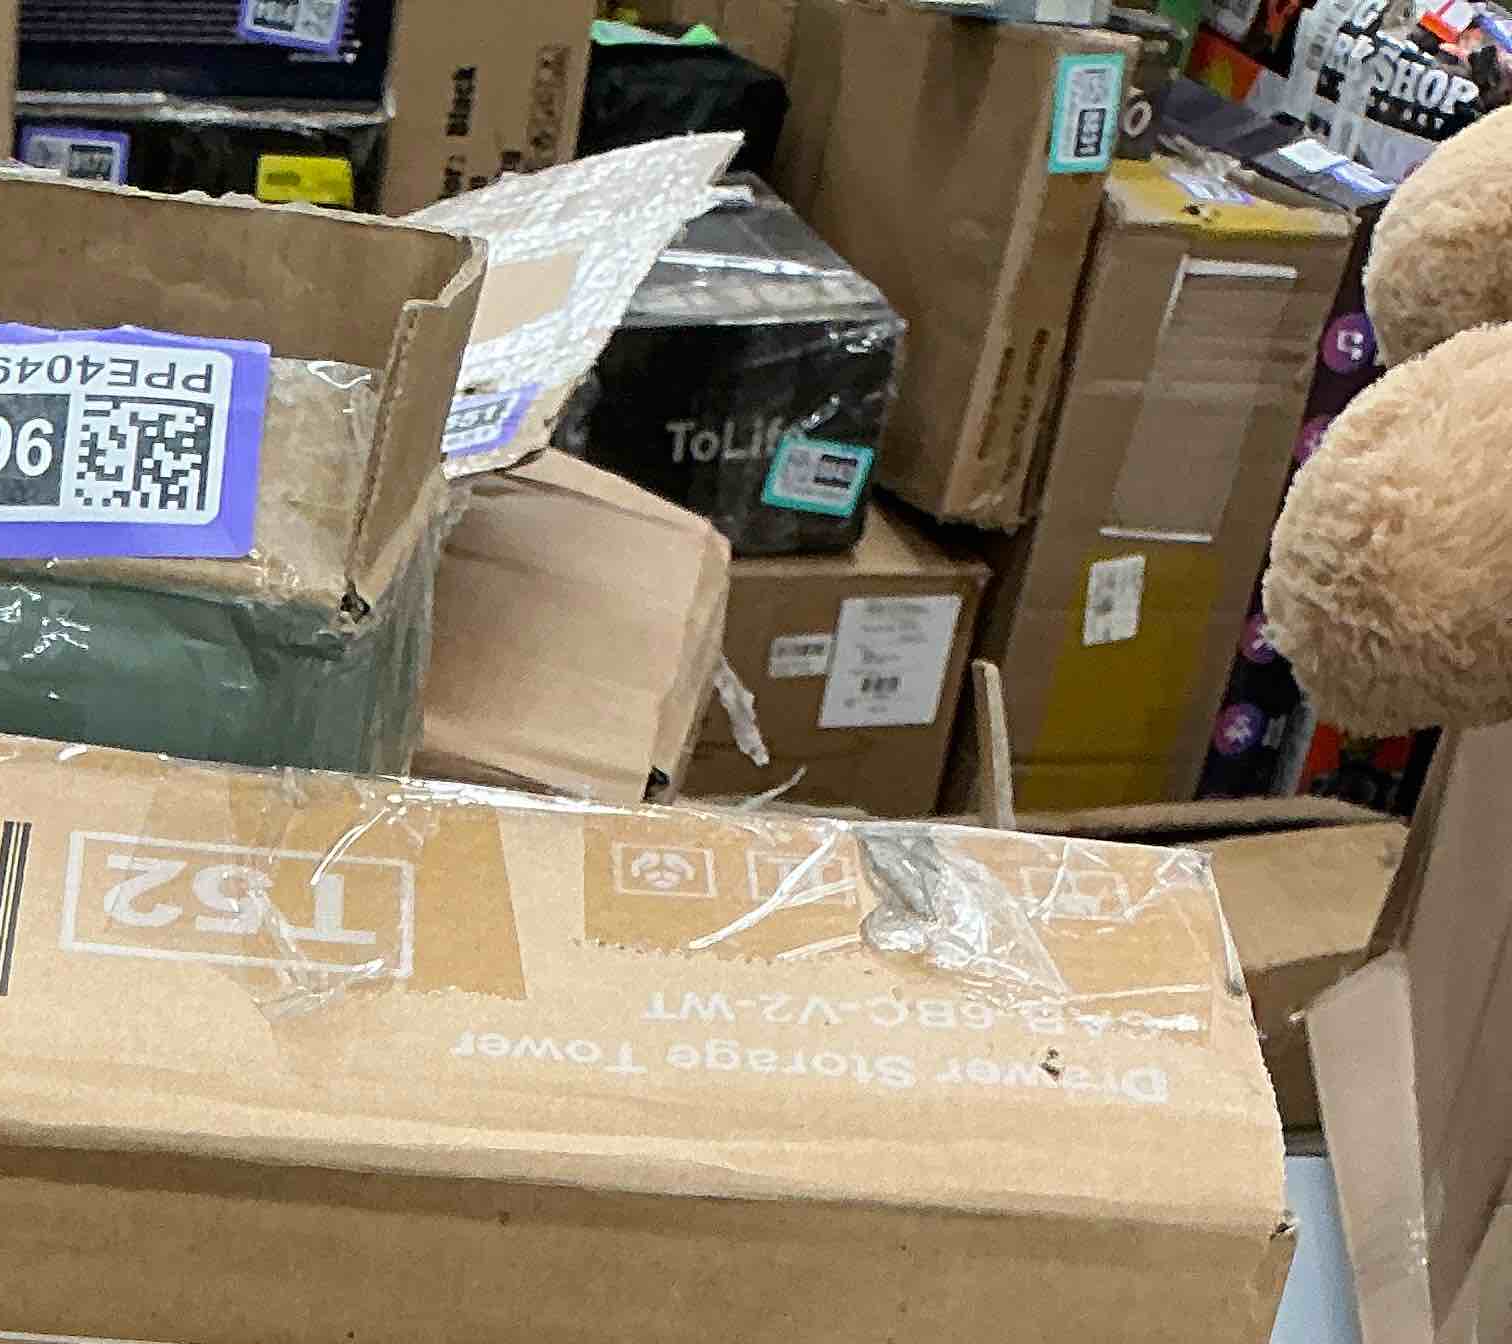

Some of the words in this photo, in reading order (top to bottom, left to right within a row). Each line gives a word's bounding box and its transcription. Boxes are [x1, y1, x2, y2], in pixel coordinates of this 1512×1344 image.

[663, 414, 786, 463] ToLif
[451, 1031, 649, 1076] Tower
[666, 1039, 915, 1090] Storage
[941, 1055, 1170, 1104] Drawer
